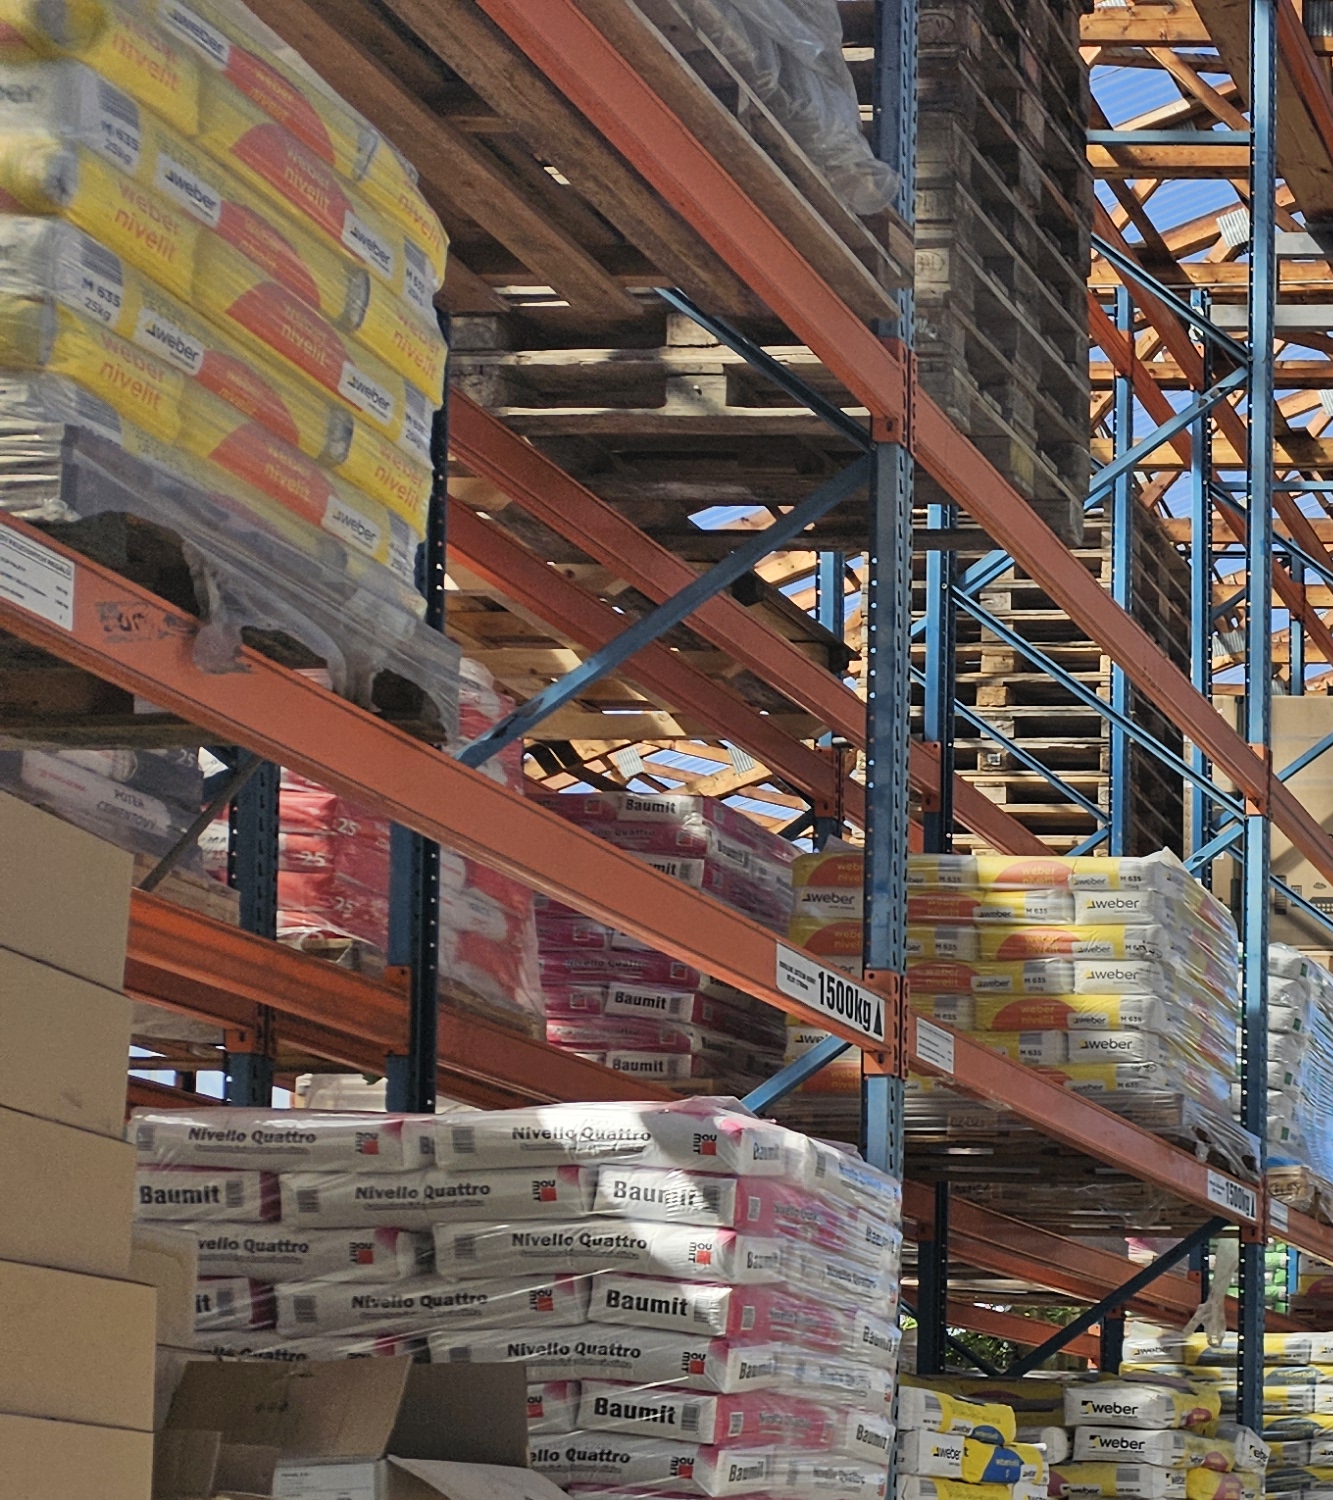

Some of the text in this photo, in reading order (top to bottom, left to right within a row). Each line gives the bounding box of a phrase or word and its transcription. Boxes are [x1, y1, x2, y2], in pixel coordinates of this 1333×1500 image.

[154, 327, 198, 362] weber
[392, 329, 437, 380] nivelit
[100, 360, 164, 411] nivelit
[374, 465, 418, 513] nivelit
[340, 512, 377, 542] weber
[626, 798, 675, 814] Baumit
[814, 893, 855, 905] weber
[1099, 898, 1139, 910] weber
[1097, 969, 1138, 980] weber
[615, 991, 666, 1009] Baumit
[818, 970, 871, 1031] 1500kg
[1088, 1039, 1133, 1050] weber
[612, 1058, 663, 1072] Baumit
[189, 1128, 316, 1145] Nivello Quattro
[139, 1185, 220, 1204] Baumit
[355, 1184, 491, 1200] Nivello Quattro
[512, 1234, 647, 1249] Nivello Quattro
[419, 1292, 488, 1308] Quattro
[607, 1289, 688, 1316] Baumit
[508, 1343, 641, 1359] Nivello Quattro
[594, 1398, 675, 1424] Baumit
[1093, 1401, 1138, 1414] weber
[1099, 1437, 1145, 1450] weber
[1070, 1486, 1099, 1495] weber
